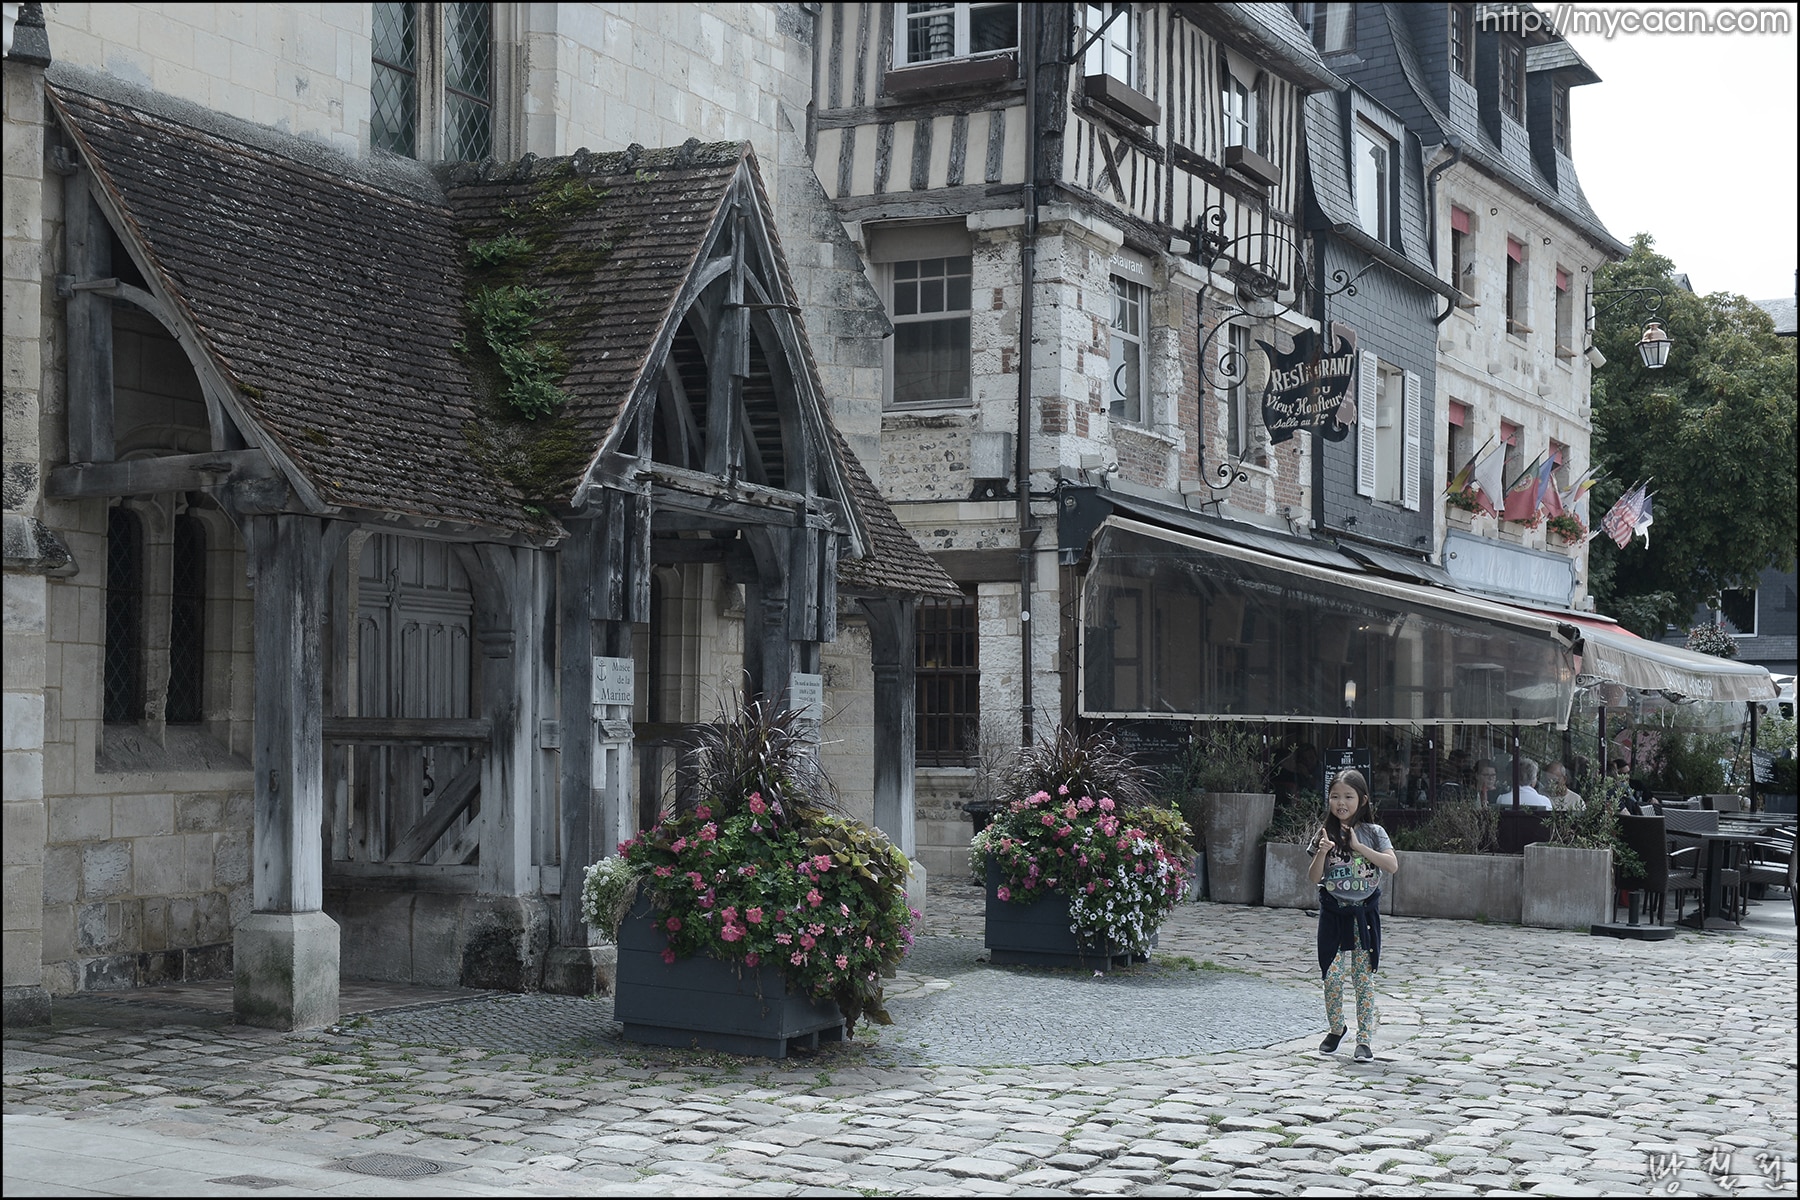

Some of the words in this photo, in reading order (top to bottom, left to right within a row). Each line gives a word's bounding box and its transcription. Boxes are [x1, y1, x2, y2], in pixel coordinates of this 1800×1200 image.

[1266, 394, 1295, 417] Vieux
[1270, 415, 1299, 429] Salle
[616, 675, 625, 685] de
[625, 675, 631, 685] la
[601, 687, 631, 701] Marine
[1336, 879, 1368, 891] COOL!
